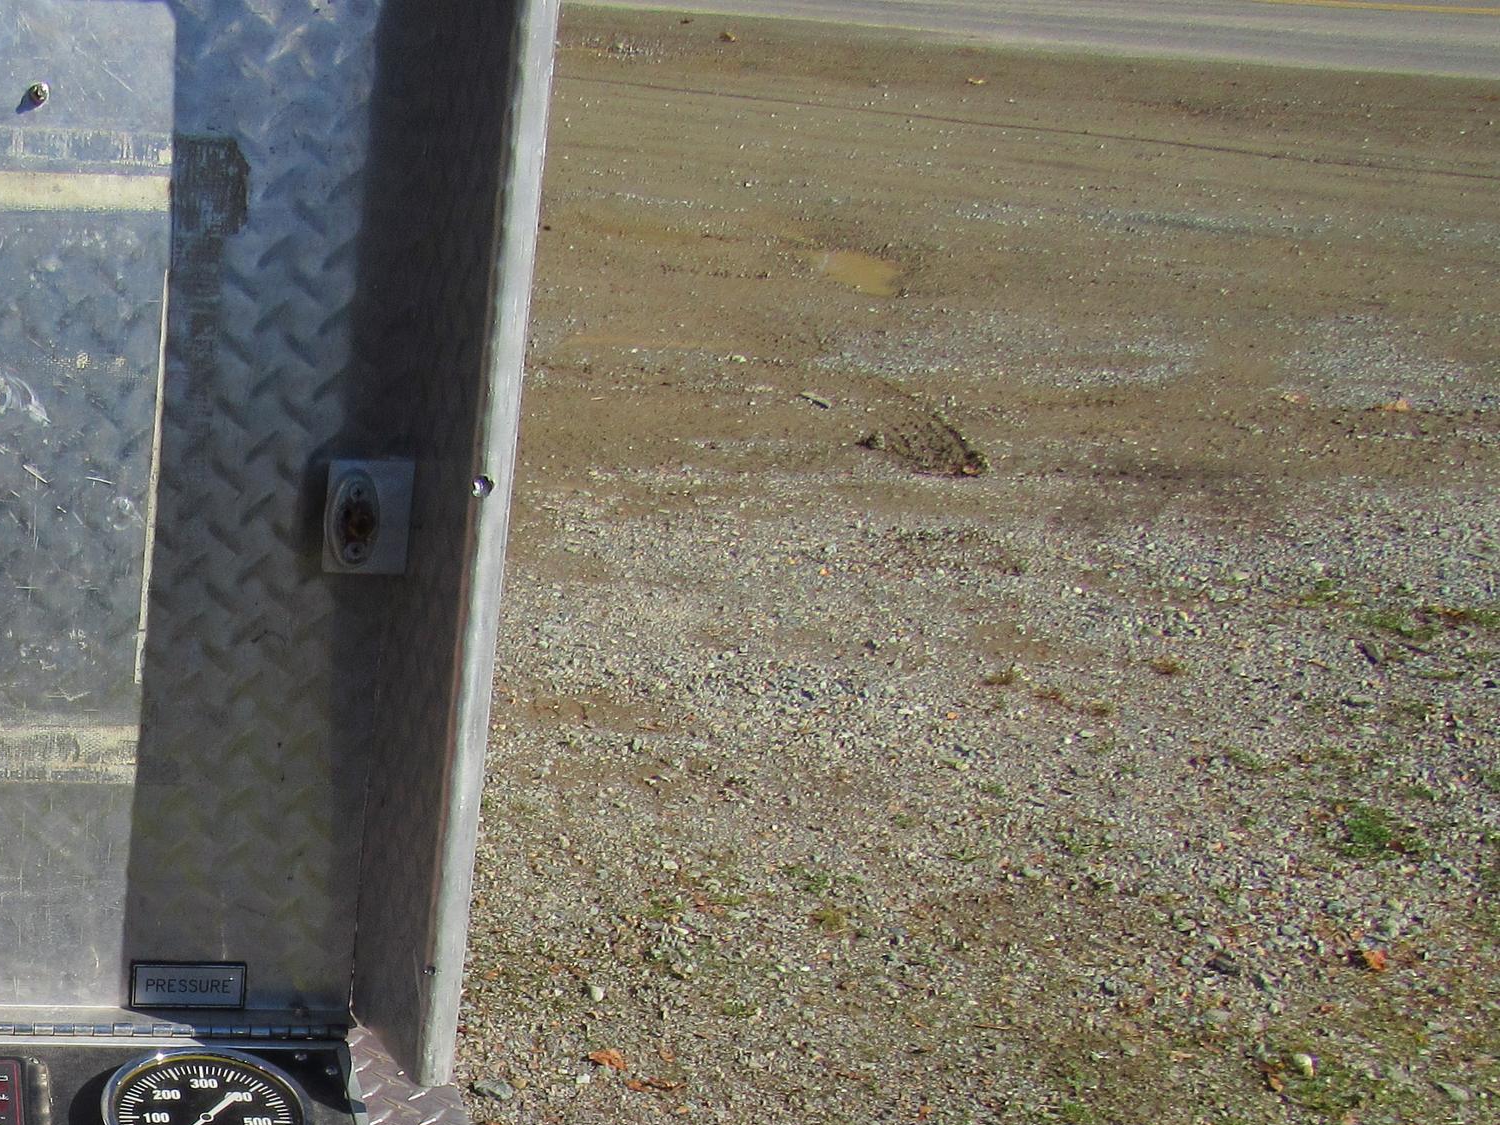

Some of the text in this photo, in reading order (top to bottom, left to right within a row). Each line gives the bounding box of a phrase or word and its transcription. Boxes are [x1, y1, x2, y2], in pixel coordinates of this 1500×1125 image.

[145, 978, 231, 994] PRESSURE
[189, 1078, 218, 1089] 300
[152, 1089, 181, 1100] 200
[143, 1112, 170, 1123] 100
